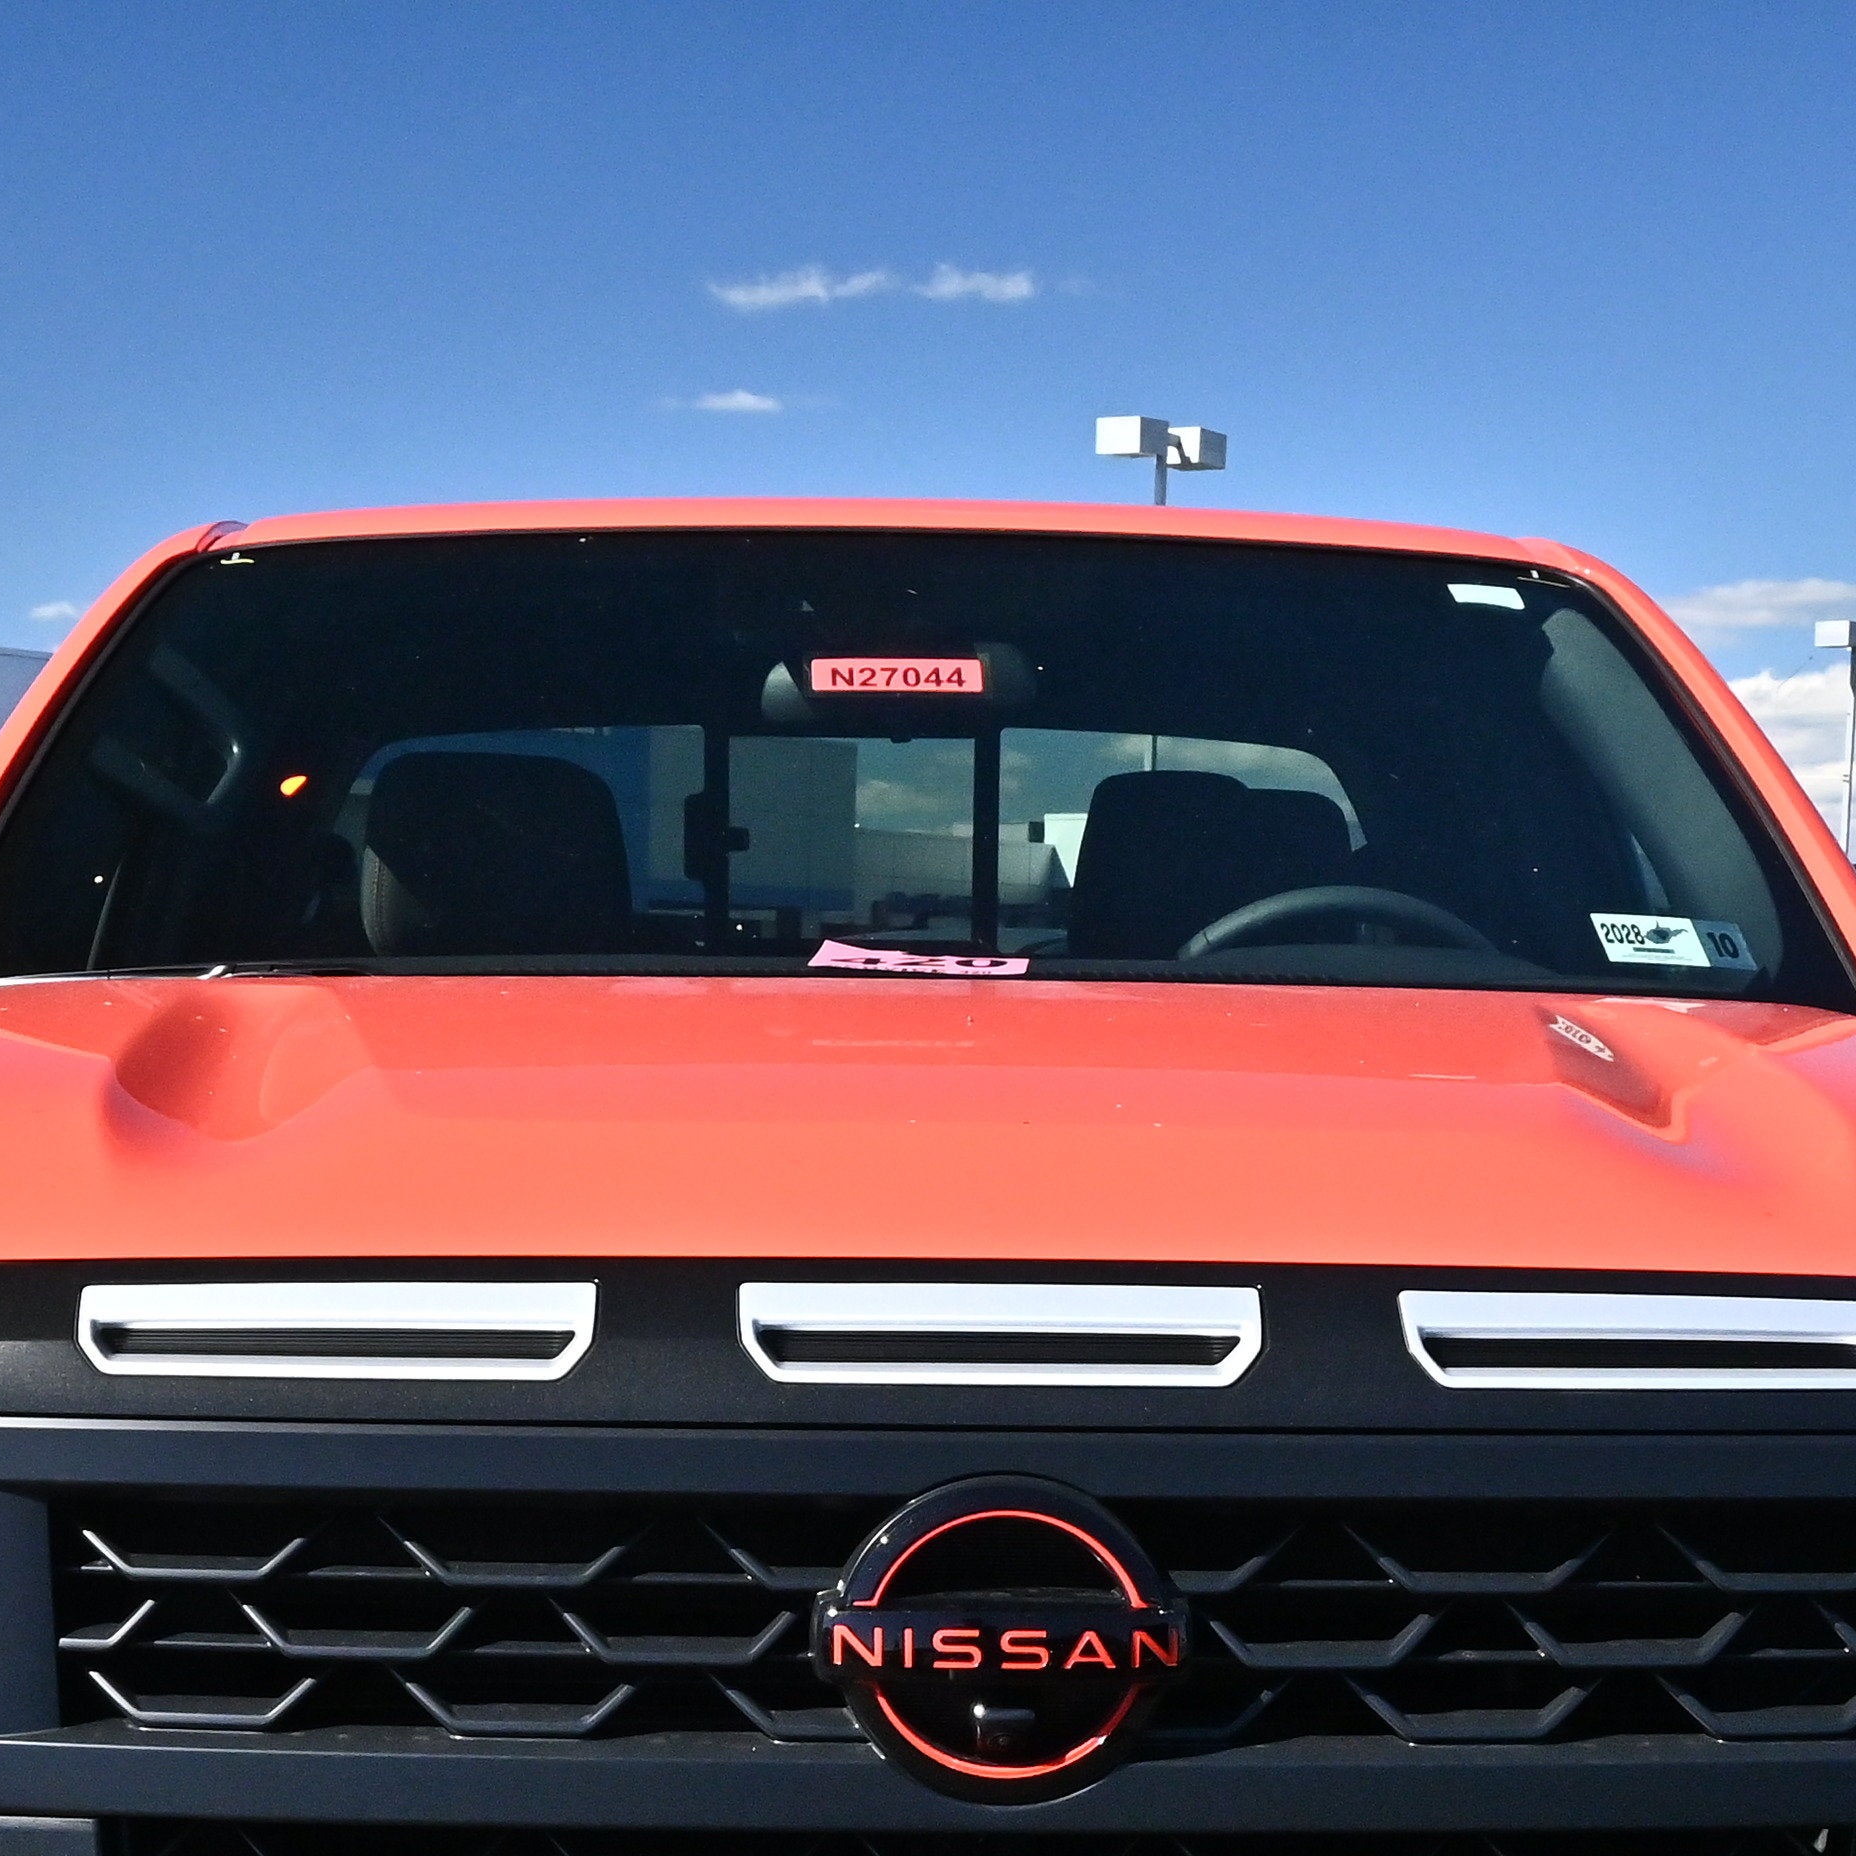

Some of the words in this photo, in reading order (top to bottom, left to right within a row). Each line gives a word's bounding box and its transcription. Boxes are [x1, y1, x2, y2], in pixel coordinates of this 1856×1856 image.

[831, 666, 966, 687] N27044
[1600, 923, 1646, 945] 2028
[1706, 932, 1740, 959] 10
[832, 1625, 1179, 1670] NISSAN
